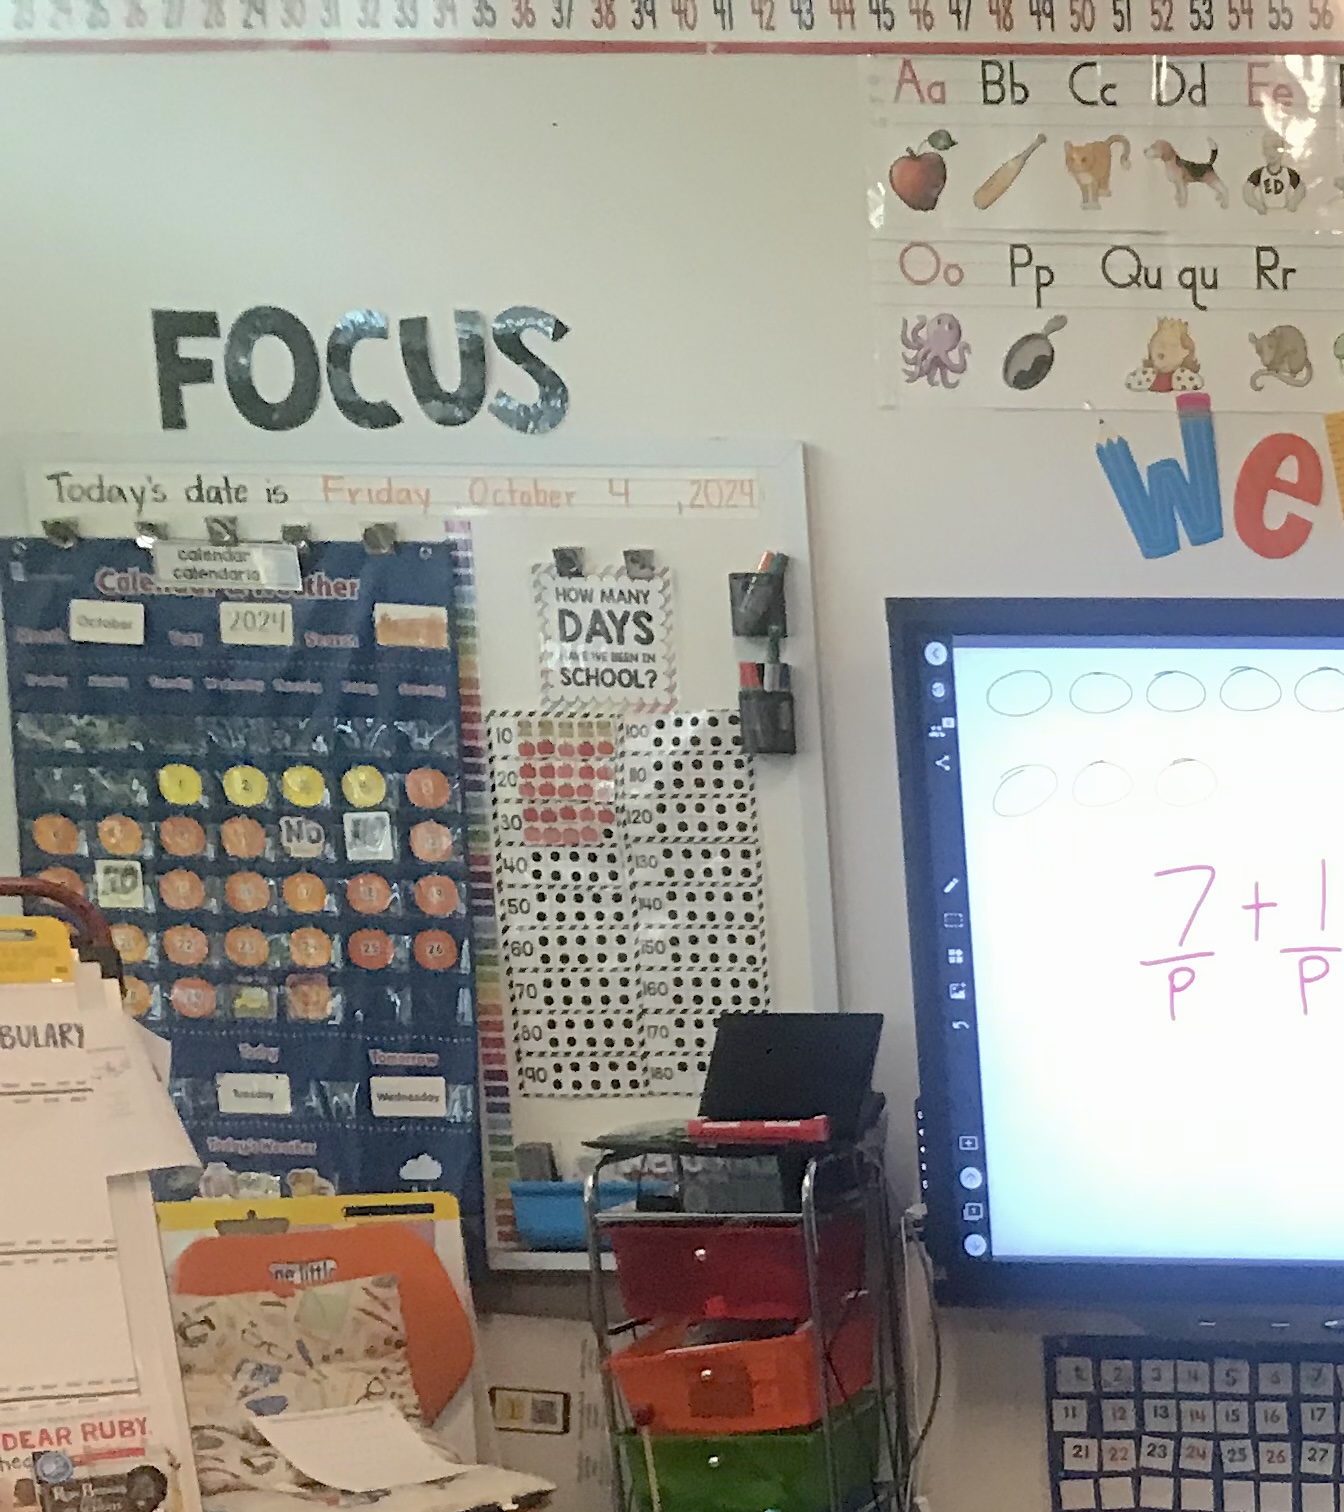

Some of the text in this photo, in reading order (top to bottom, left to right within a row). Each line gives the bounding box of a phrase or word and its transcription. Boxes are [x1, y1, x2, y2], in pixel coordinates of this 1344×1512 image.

[894, 60, 945, 104] Aa
[980, 60, 1029, 106] Bb
[1069, 62, 1117, 106] Cc
[1156, 62, 1207, 106] Dd
[900, 241, 964, 286] Oo
[1010, 244, 1054, 308] Pp
[1102, 246, 1162, 289] Qu
[1178, 264, 1218, 310] qu
[1256, 246, 1296, 290] Rr
[151, 305, 571, 434] FOCUS
[46, 472, 168, 514] Today's
[185, 474, 249, 504] date
[265, 477, 290, 504] is
[321, 474, 431, 518] Friday
[468, 477, 577, 507] October
[607, 477, 631, 507] 4
[177, 548, 251, 563] calendar
[171, 567, 261, 582] calendario
[555, 587, 651, 604] HOW MANY
[228, 608, 287, 634] 2024
[558, 607, 656, 646] DAYS
[559, 668, 659, 689] SCHOOL?
[496, 727, 513, 744] 10
[497, 771, 518, 787] 20
[500, 814, 523, 831] 30
[508, 898, 531, 915] 50
[1155, 865, 1216, 948] 7
[514, 983, 538, 999] 70
[525, 1067, 548, 1083] 90
[1063, 1406, 1077, 1419] 11
[1225, 1408, 1239, 1422] 15
[1310, 1406, 1326, 1421] 17
[2, 1417, 147, 1450] DEAR RUBY
[1073, 1445, 1090, 1459] 21
[1147, 1443, 1167, 1458] 23
[1308, 1447, 1328, 1462] 27
